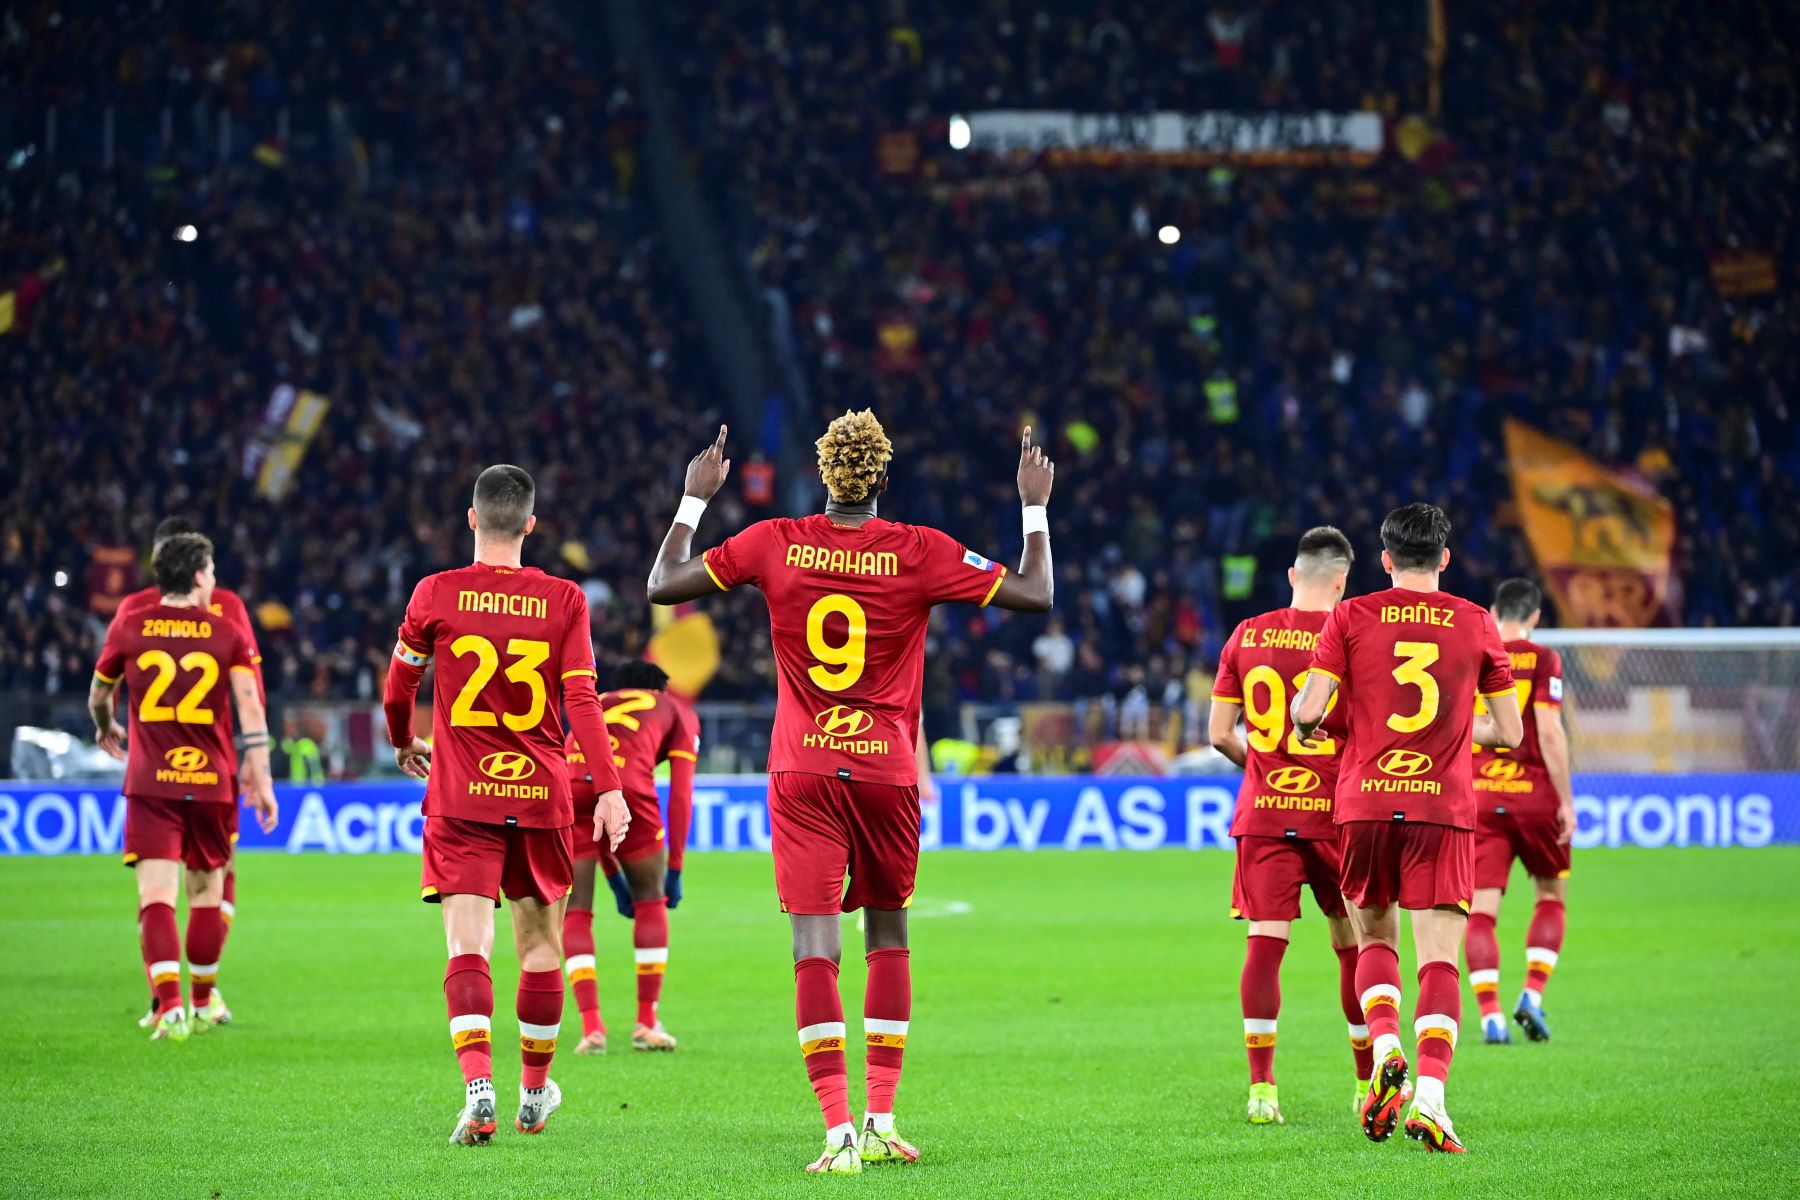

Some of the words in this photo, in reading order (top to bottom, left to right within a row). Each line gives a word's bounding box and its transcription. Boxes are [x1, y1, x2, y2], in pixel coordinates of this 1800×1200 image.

[785, 543, 898, 576] ABRAHAM
[457, 590, 547, 620] MANCINI
[1380, 601, 1456, 628] IBAÑEZ
[141, 618, 213, 639] ZANIOLO
[806, 593, 868, 692] 9
[1240, 627, 1257, 648] EL
[136, 649, 220, 725] 22
[449, 634, 550, 732] 23
[1386, 641, 1440, 734] 3
[802, 733, 889, 755] HYUNDAI
[156, 768, 218, 785] HYUNDAI
[468, 781, 549, 800] HYUNDAI
[1360, 778, 1442, 796] HYUNDAI
[960, 783, 1049, 851] by
[1062, 786, 1167, 851] AS
[1254, 795, 1332, 812] HYUNDAI
[286, 792, 424, 854] Acro
[1571, 794, 1774, 849] cronis
